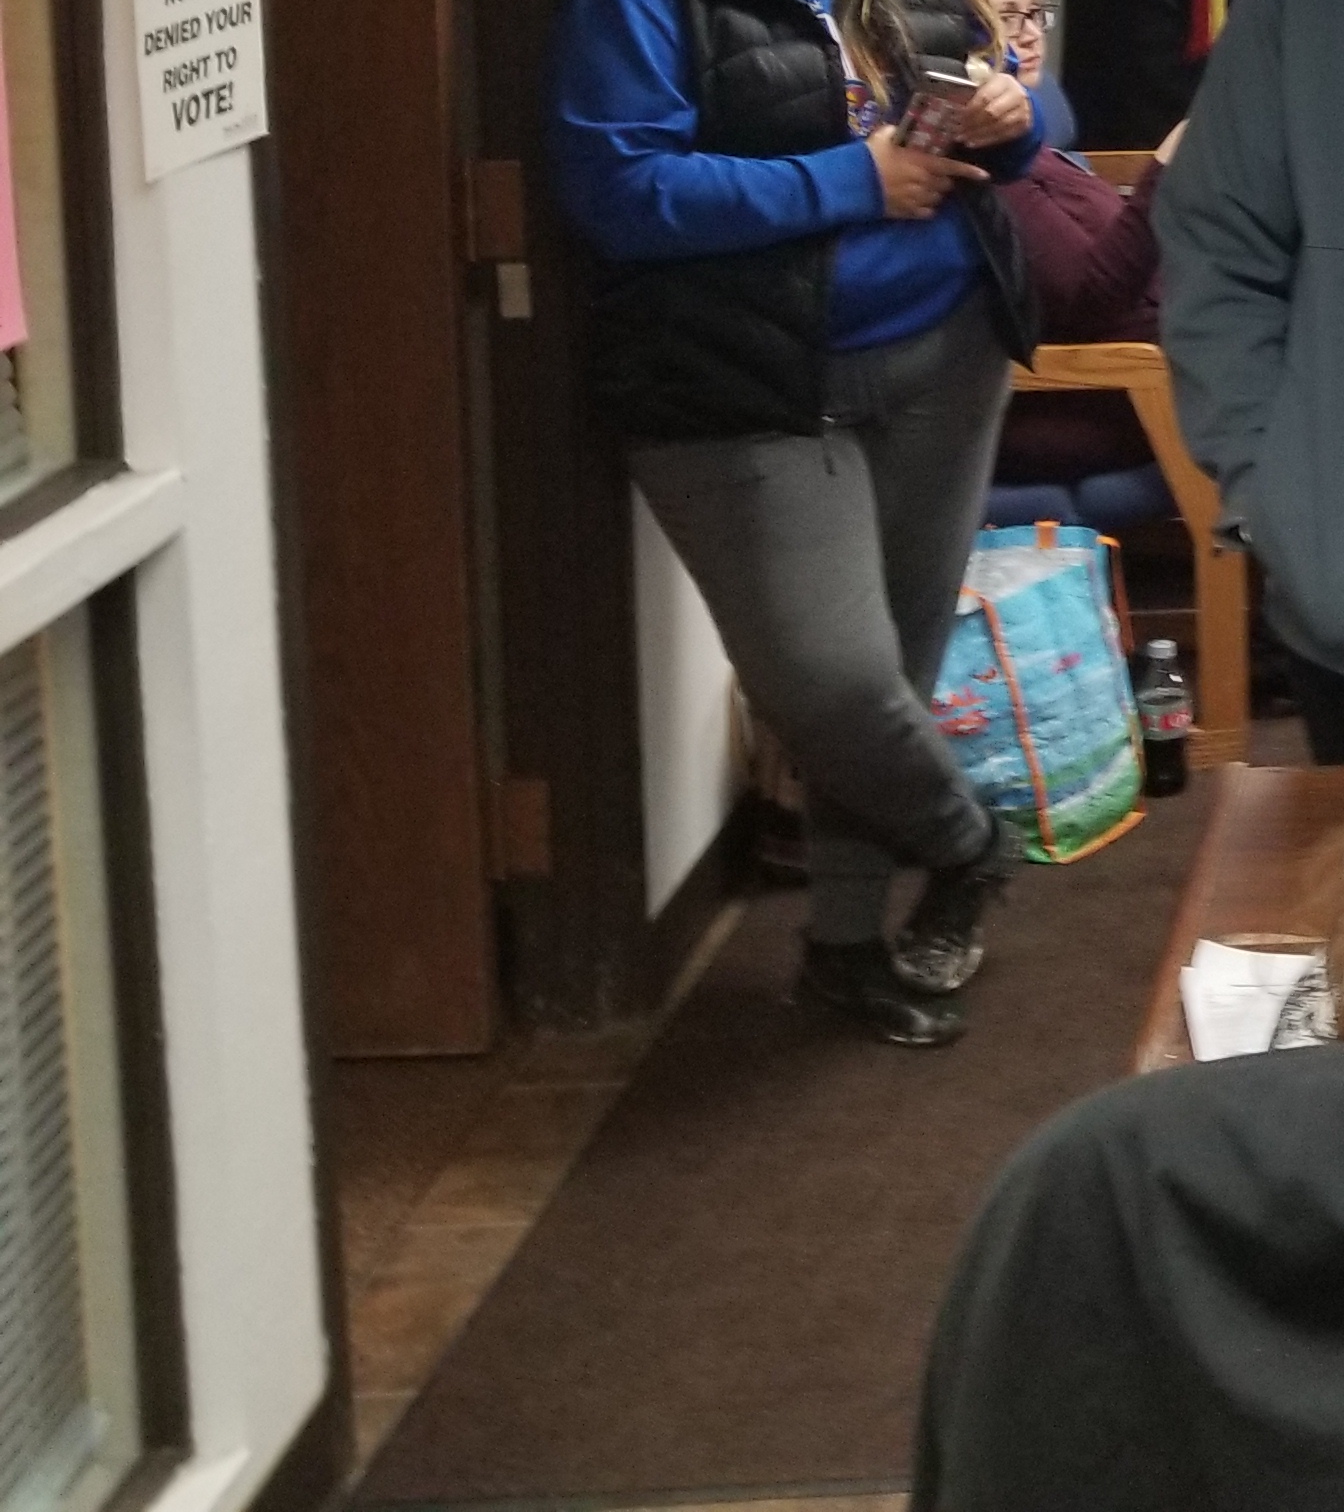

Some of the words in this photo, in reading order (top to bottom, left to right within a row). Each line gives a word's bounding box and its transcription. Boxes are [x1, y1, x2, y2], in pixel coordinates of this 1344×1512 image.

[144, 16, 201, 56] DENIED
[205, 1, 252, 34] YOUR
[163, 55, 210, 93] RIGHT
[215, 46, 237, 73] TO
[172, 81, 234, 131] VOTE!
